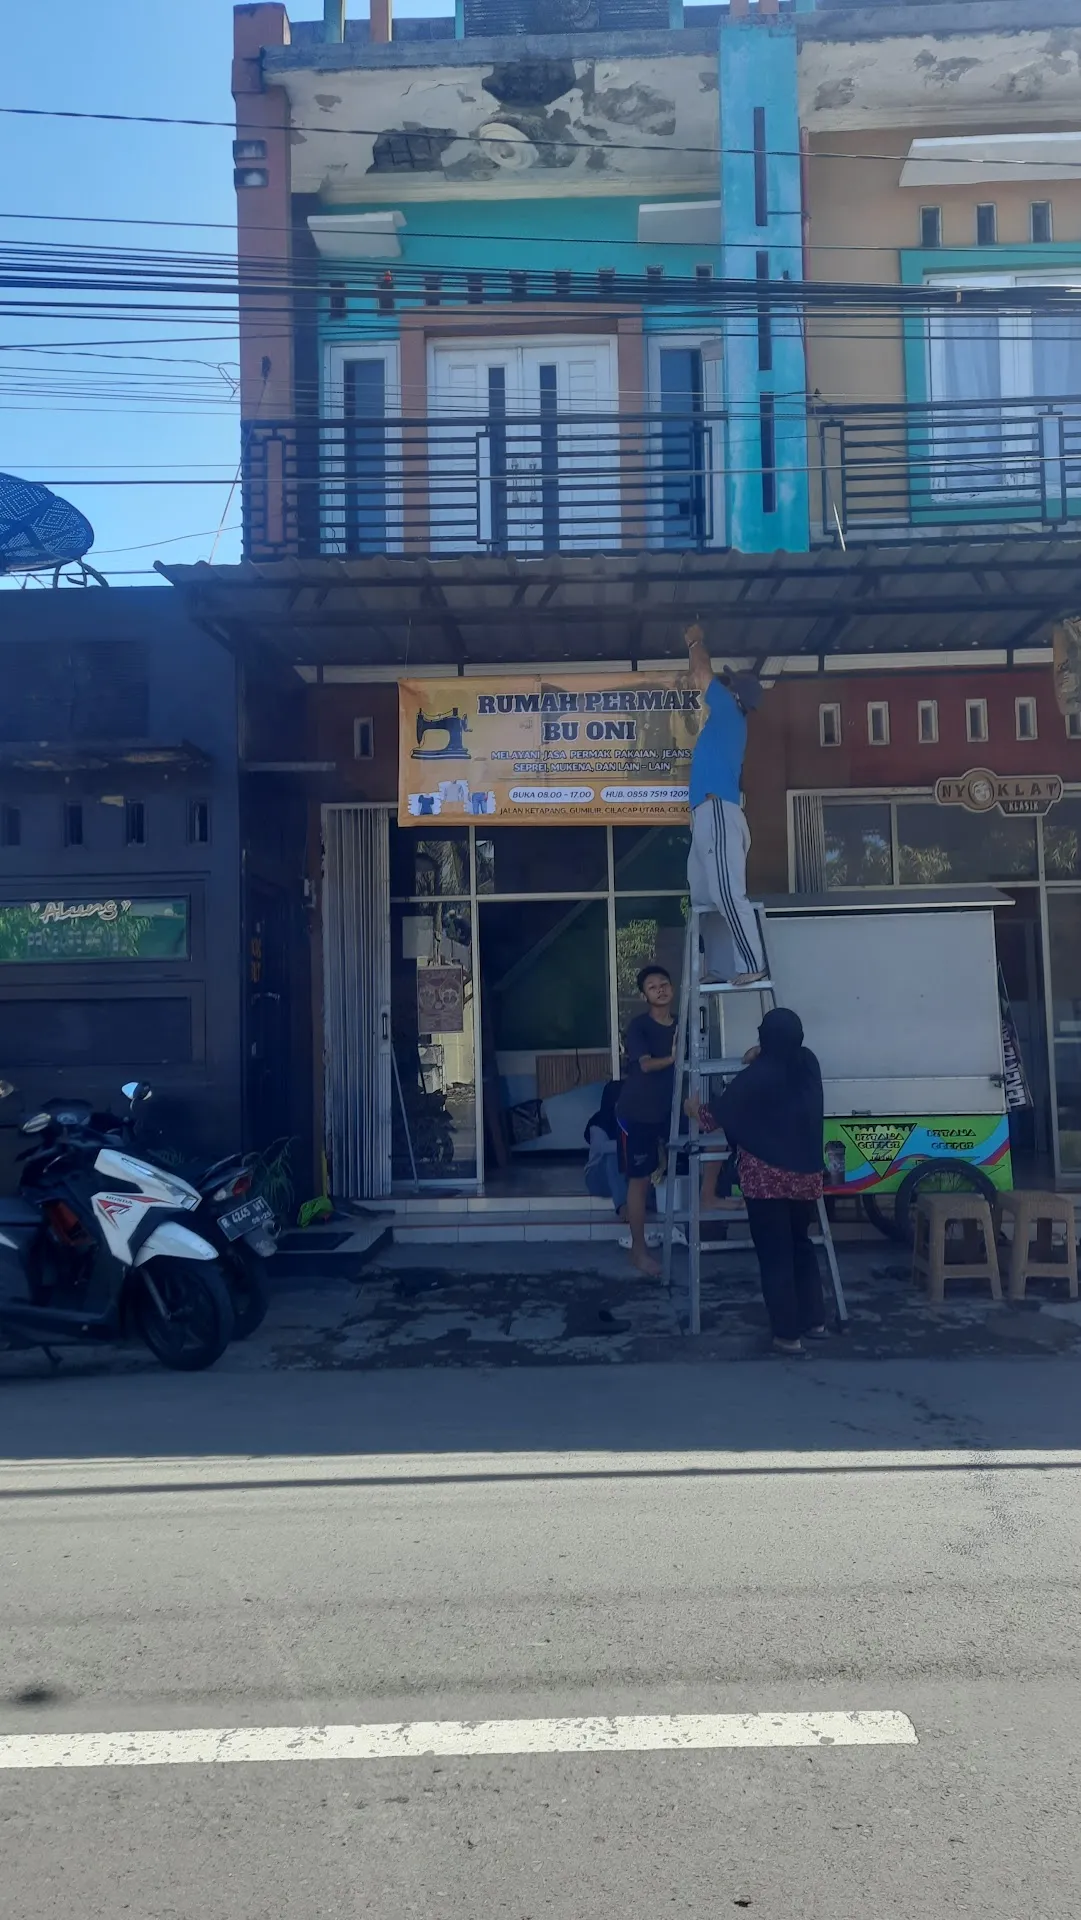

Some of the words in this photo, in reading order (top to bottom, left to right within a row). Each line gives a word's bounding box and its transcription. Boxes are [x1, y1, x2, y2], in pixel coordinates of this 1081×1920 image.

[477, 692, 579, 714] RUMAH
[584, 690, 702, 712] PERMAK
[543, 720, 580, 742] BU
[585, 720, 637, 741] ONI
[491, 751, 540, 760] MELAYANI
[543, 751, 567, 760] JASA
[570, 750, 612, 760] PERMAK
[513, 763, 549, 773] SEPREI,
[550, 762, 594, 773] MUKENA,
[595, 762, 617, 771] DAN
[618, 762, 640, 772] LAIN
[648, 762, 671, 771] LAIN
[512, 791, 535, 799] BUKA
[537, 791, 562, 799] 08.00
[626, 790, 648, 798] 0858
[650, 790, 668, 798] 7519
[669, 790, 689, 798] 1209
[500, 807, 524, 815] JALAN
[1008, 801, 1039, 812] KLASIK
[105, 1195, 133, 1205] HONDA
[221, 1217, 231, 1229] R
